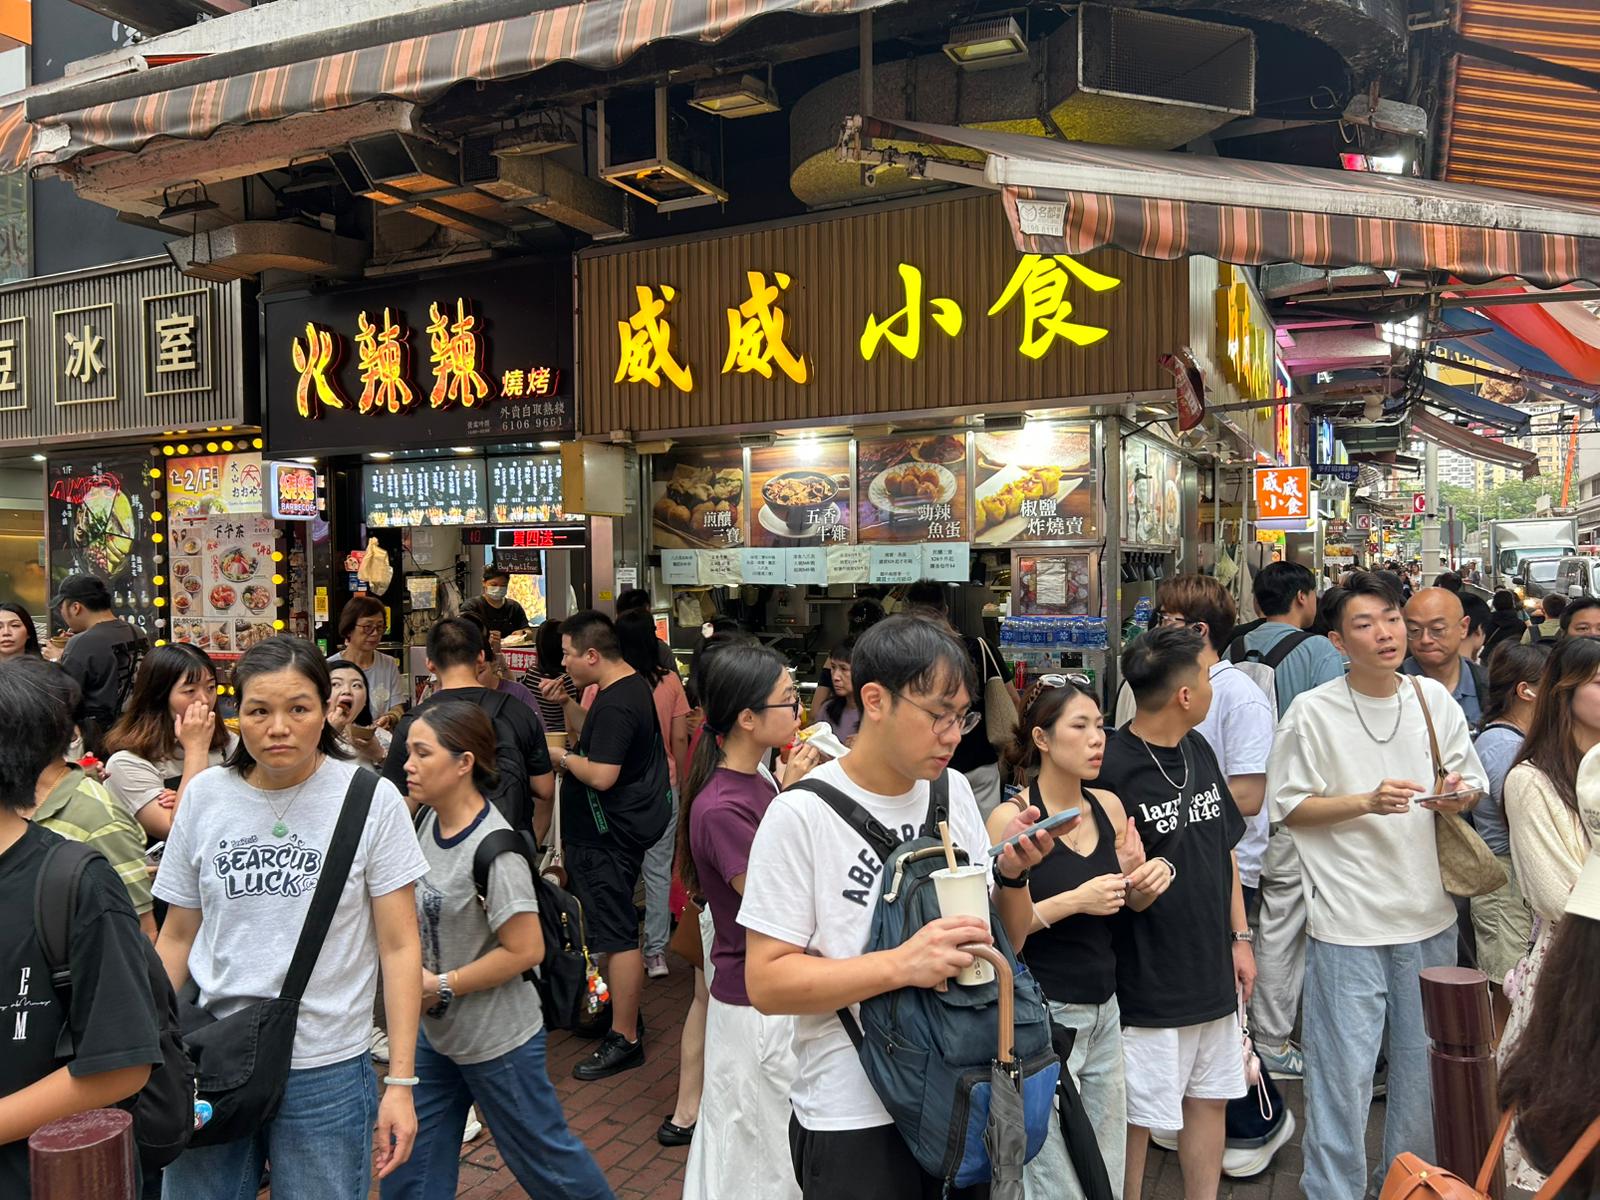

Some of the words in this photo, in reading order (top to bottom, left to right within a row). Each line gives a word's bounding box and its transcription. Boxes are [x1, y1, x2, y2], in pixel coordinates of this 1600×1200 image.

[613, 254, 1121, 393] 威威小食
[291, 297, 489, 418] 火辣辣
[501, 366, 551, 397] 燒烤
[502, 419, 530, 431] 6106
[535, 416, 563, 429] 9661
[184, 467, 211, 493] 2/F
[1263, 472, 1302, 497] 威威
[917, 504, 951, 521] 勁辣
[1020, 498, 1057, 517] 椒鹽
[1265, 494, 1303, 515] 小食
[703, 511, 732, 528] 煎釀
[806, 509, 837, 525] 五香
[1027, 516, 1083, 536] 炸燒賣
[513, 530, 567, 547] 買四送一
[712, 527, 740, 544] 三寶
[817, 525, 847, 542] 牛雜
[928, 521, 961, 539] 魚蛋
[215, 846, 320, 875] BEARCUB
[227, 868, 302, 896] LUCK
[18, 967, 31, 996] E
[12, 1011, 28, 1040] M
